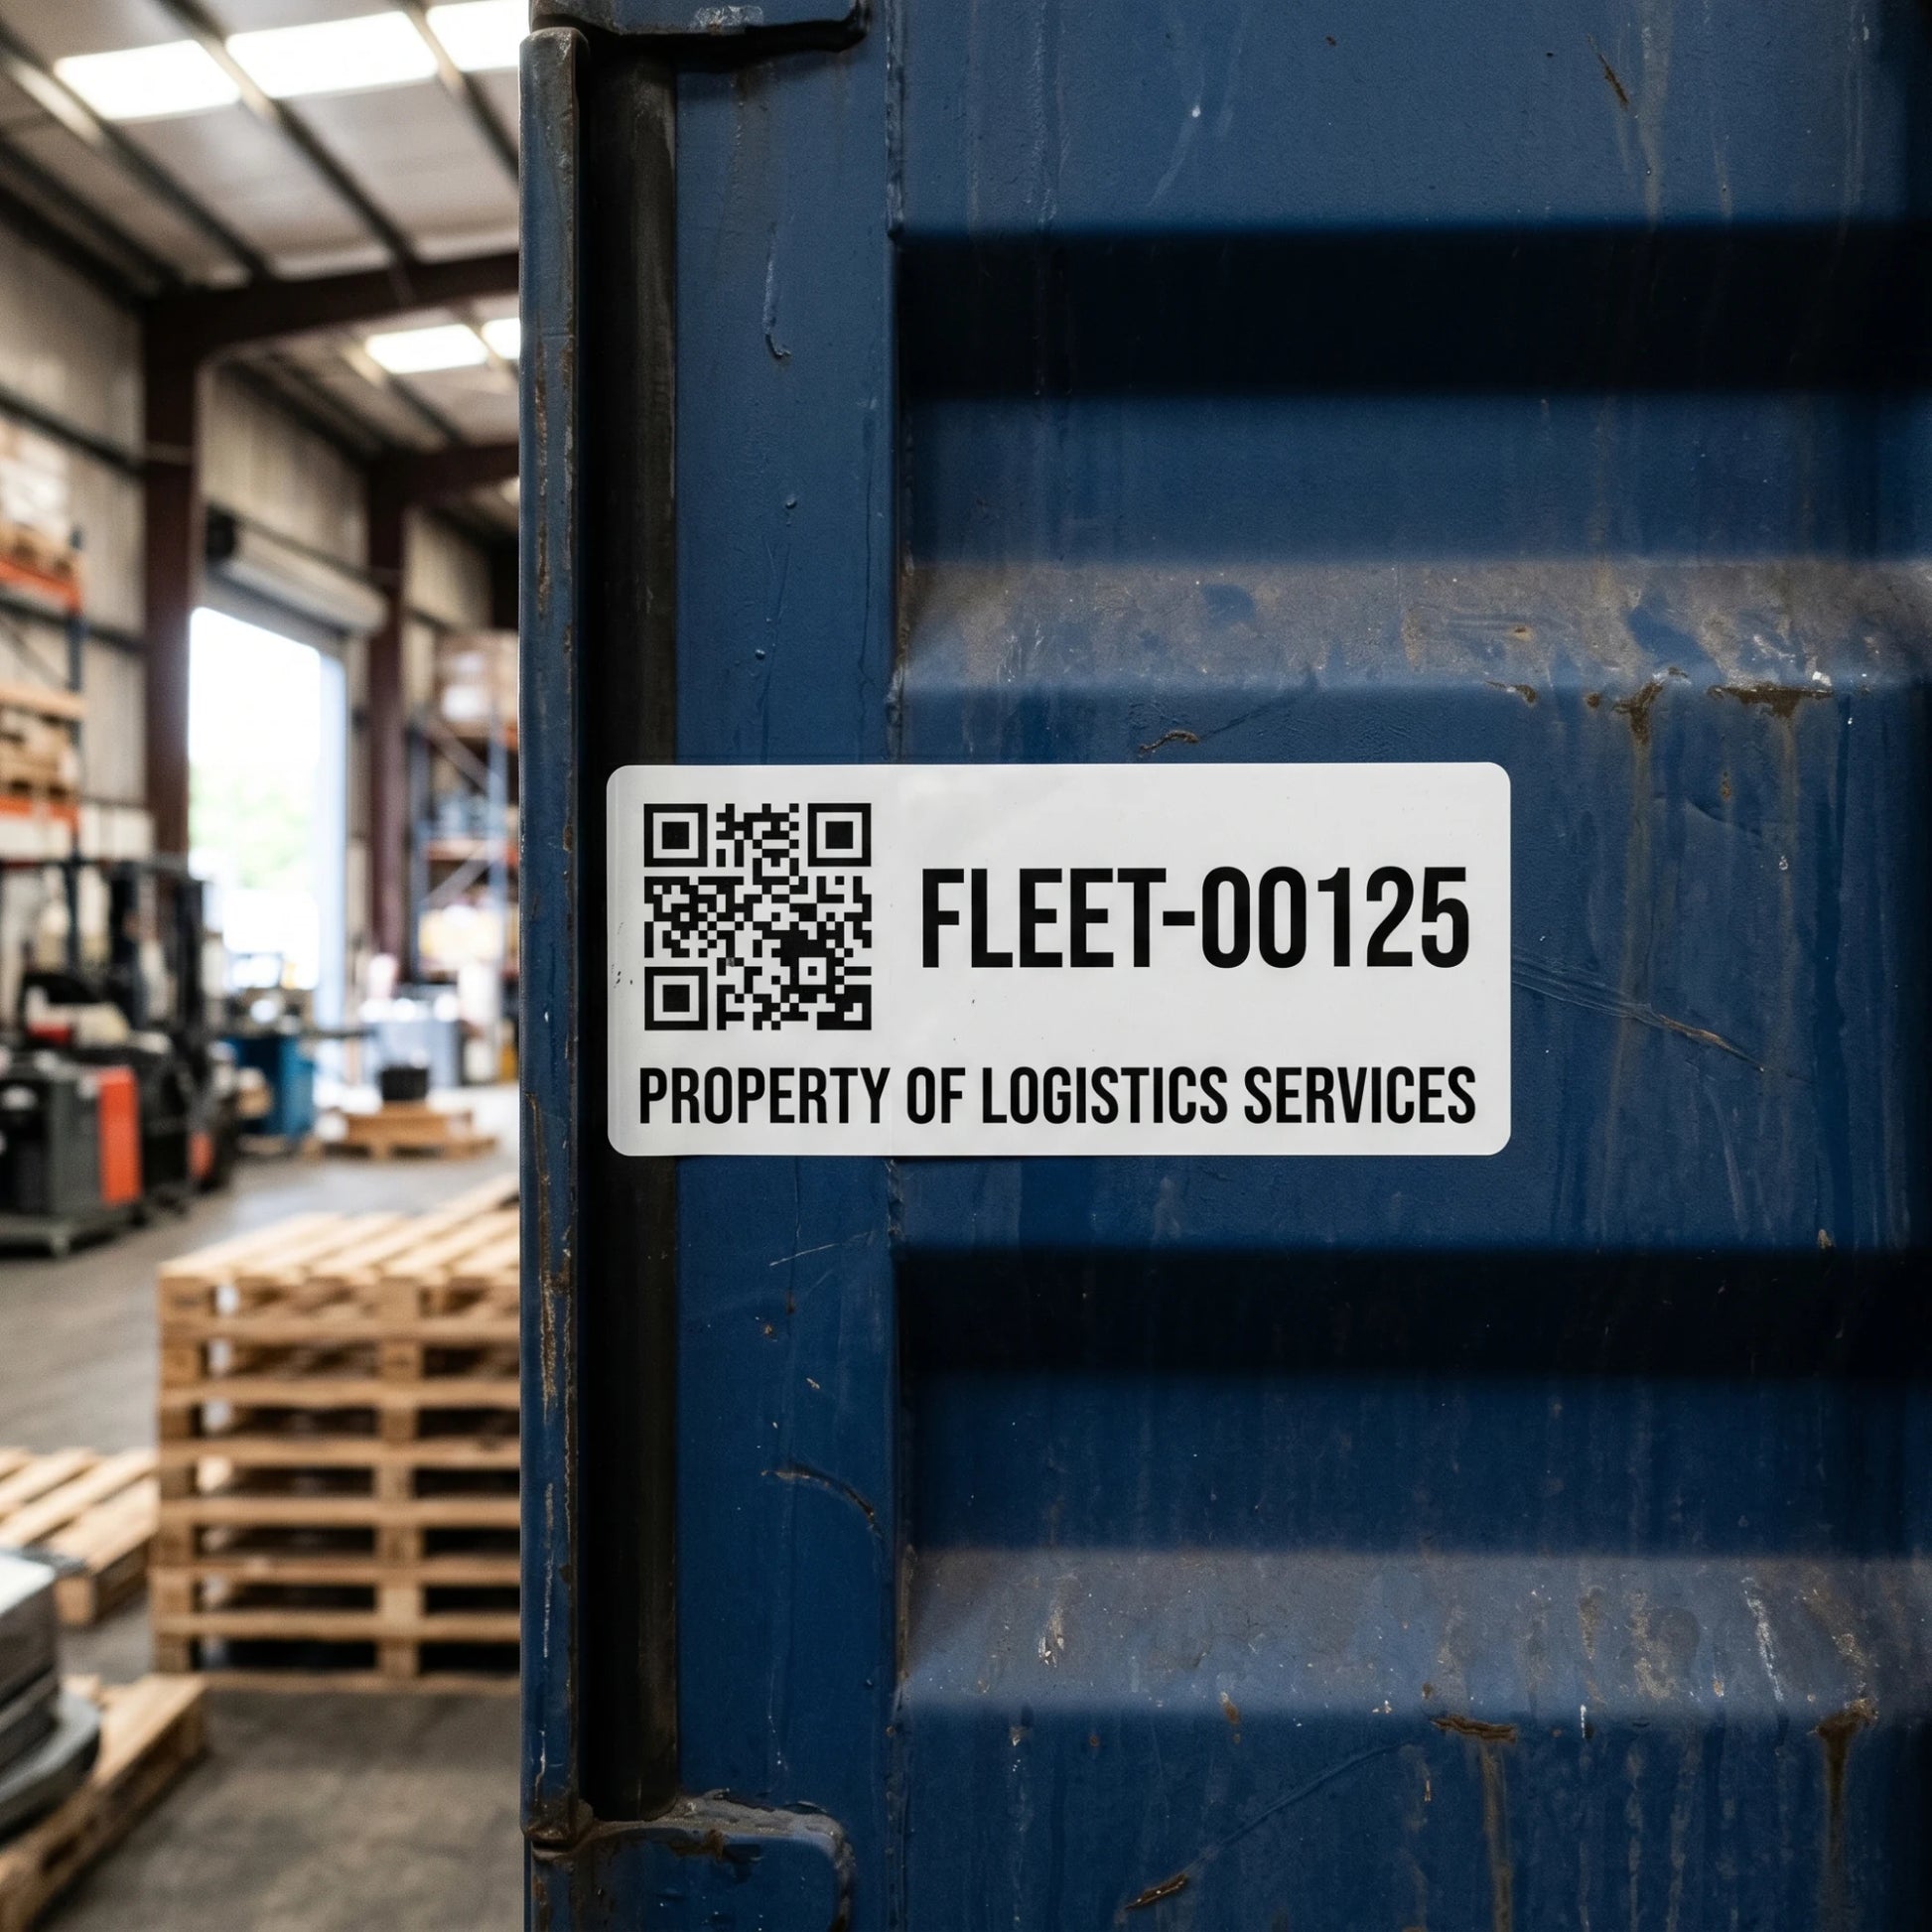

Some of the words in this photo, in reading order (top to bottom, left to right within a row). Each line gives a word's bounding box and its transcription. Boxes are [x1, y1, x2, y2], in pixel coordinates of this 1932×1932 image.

[922, 867, 1469, 969] FLEET-00125
[639, 1066, 892, 1125] PROPERTY
[906, 1066, 966, 1125] OF
[982, 1065, 1228, 1125] LOGISTICS
[1244, 1065, 1476, 1125] SERVICES
